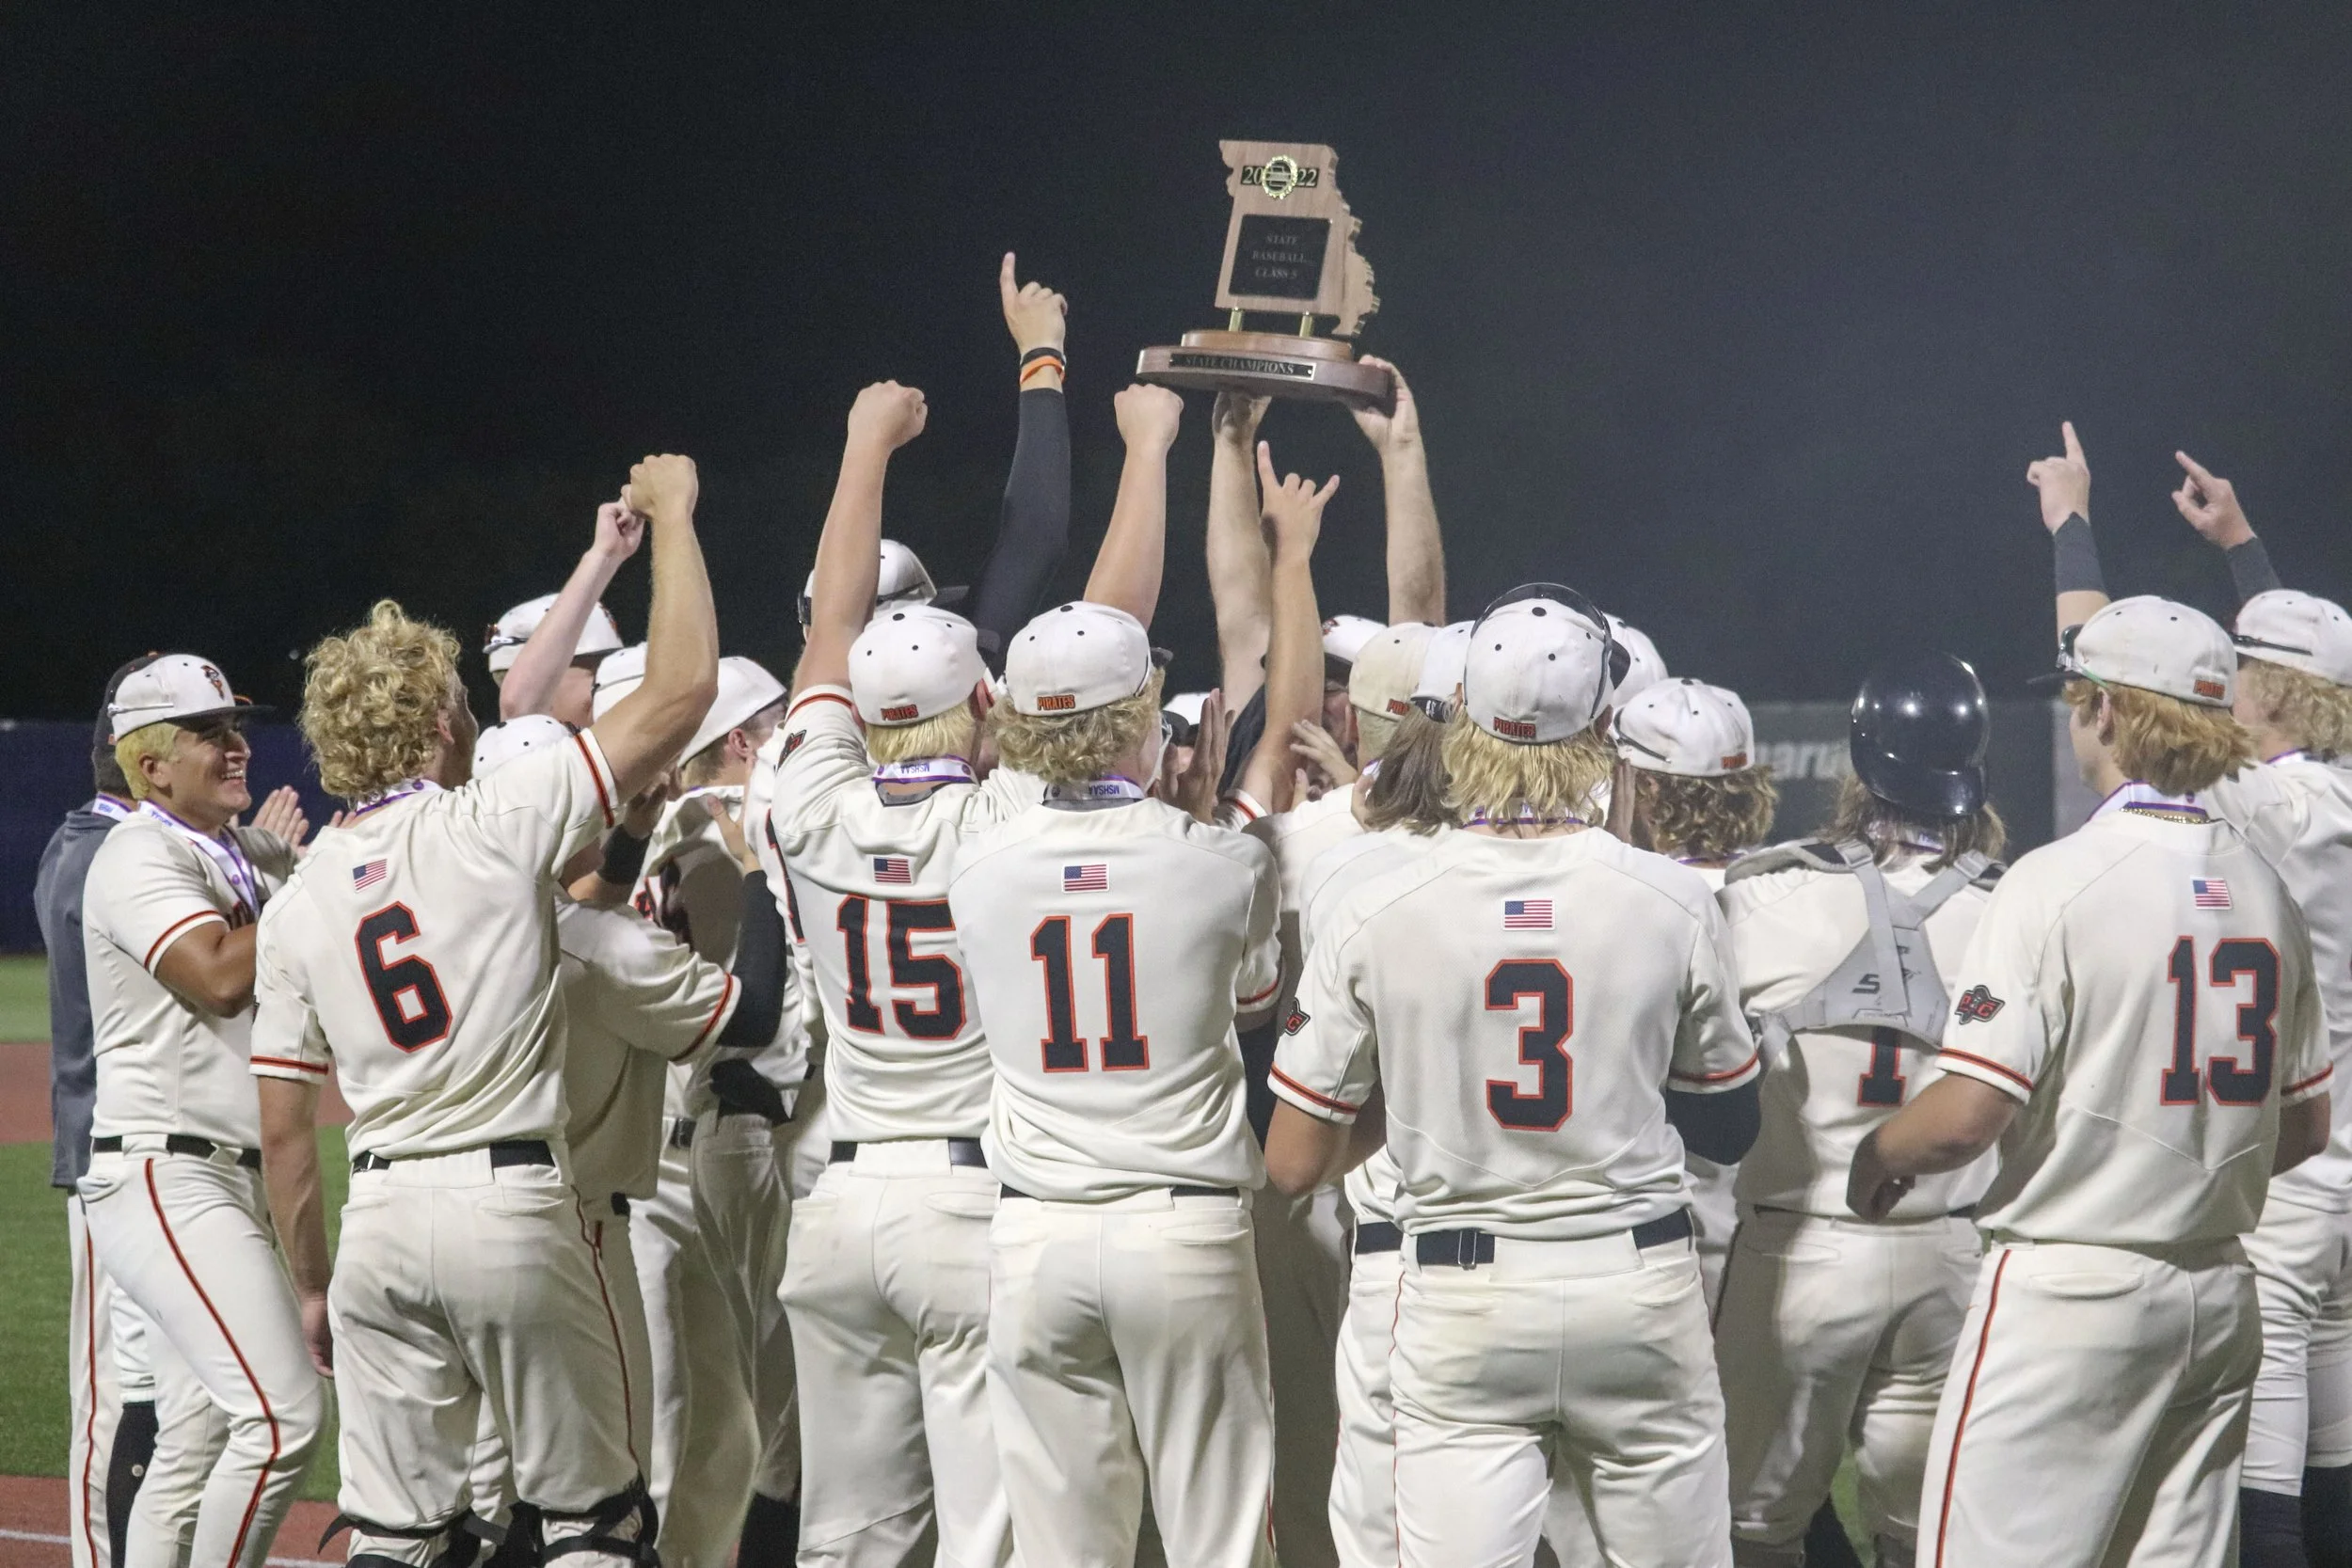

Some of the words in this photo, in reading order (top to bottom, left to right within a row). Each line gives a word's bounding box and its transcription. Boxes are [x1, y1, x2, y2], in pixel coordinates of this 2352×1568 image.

[1243, 166, 1263, 185] 20
[1297, 168, 1317, 187] 22
[1265, 234, 1299, 245] STATE
[1251, 250, 1306, 264] BASEBALL
[1254, 267, 1288, 279] CLASS
[1185, 355, 1217, 368] STATE
[1219, 356, 1295, 375] CHAMPIONS
[881, 704, 919, 721] PIRATES
[1037, 694, 1075, 711] PIRATES
[1493, 716, 1536, 738] PIRATES
[899, 763, 930, 775] MSHSAA
[1088, 784, 1120, 796] MSHSAA
[836, 893, 967, 1040] 15
[354, 900, 453, 1054] 6
[1030, 913, 1150, 1073] 11
[2160, 935, 2281, 1106] 13
[1485, 958, 1574, 1132] 3
